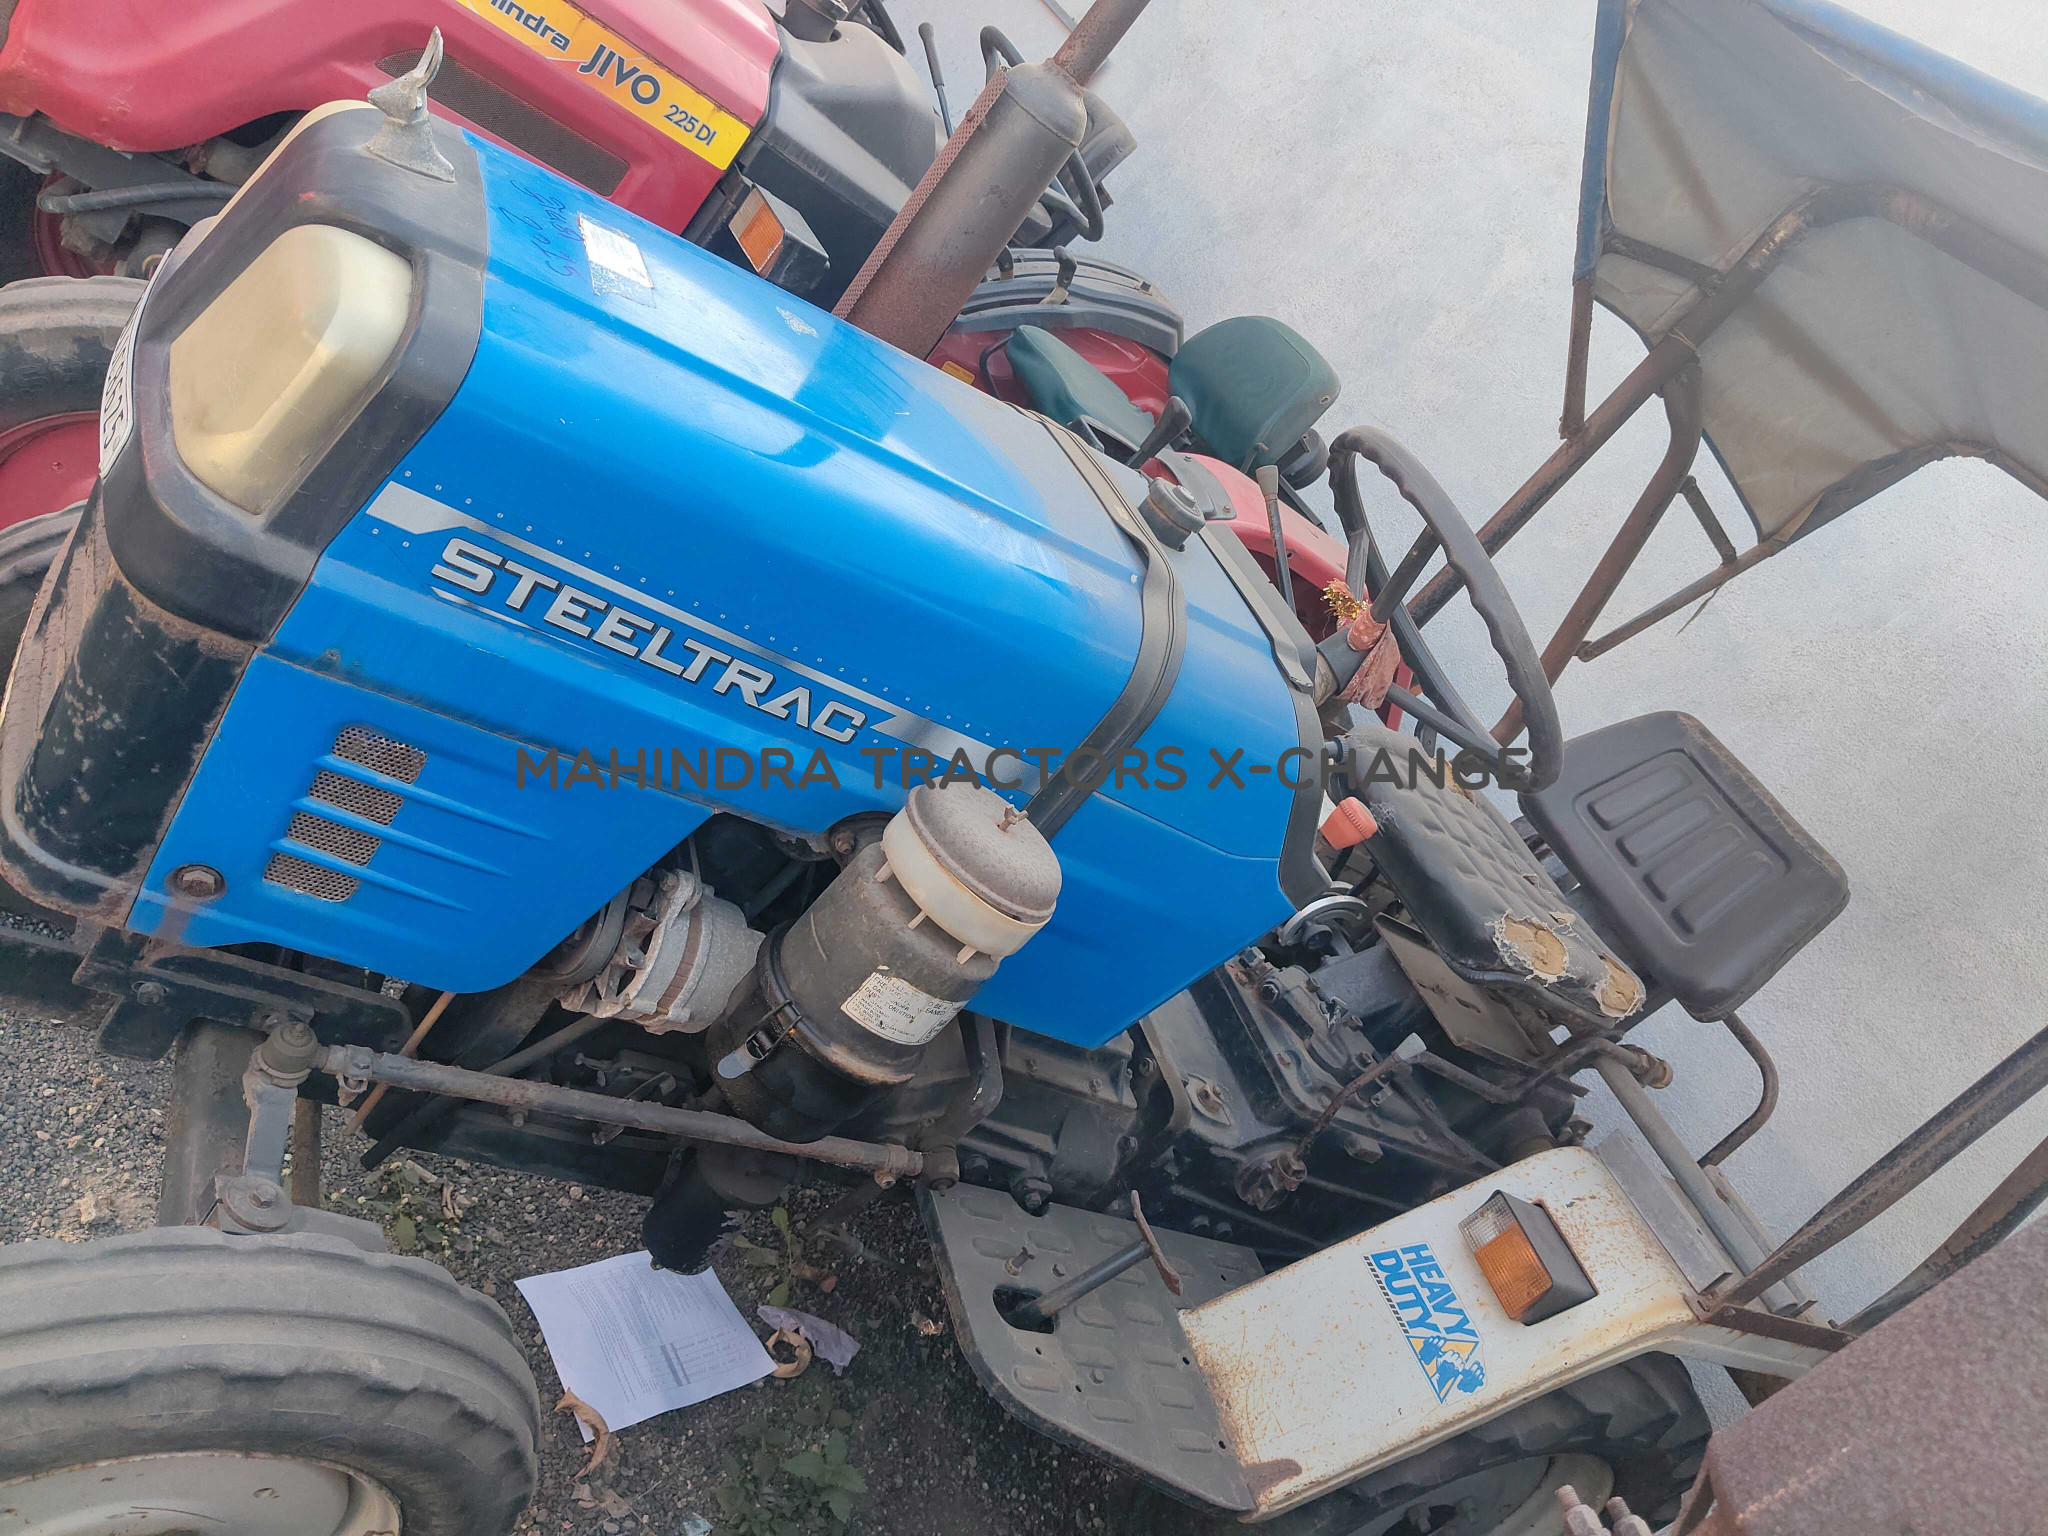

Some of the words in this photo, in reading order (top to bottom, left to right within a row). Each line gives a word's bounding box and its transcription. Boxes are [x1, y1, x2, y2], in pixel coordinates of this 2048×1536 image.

[577, 43, 661, 104] JIVO
[664, 104, 698, 133] 225
[695, 123, 717, 146] DI
[431, 537, 868, 744] STEELTRAC
[1370, 1249, 1442, 1334] DUTY
[1400, 1243, 1479, 1338] HEAVY
